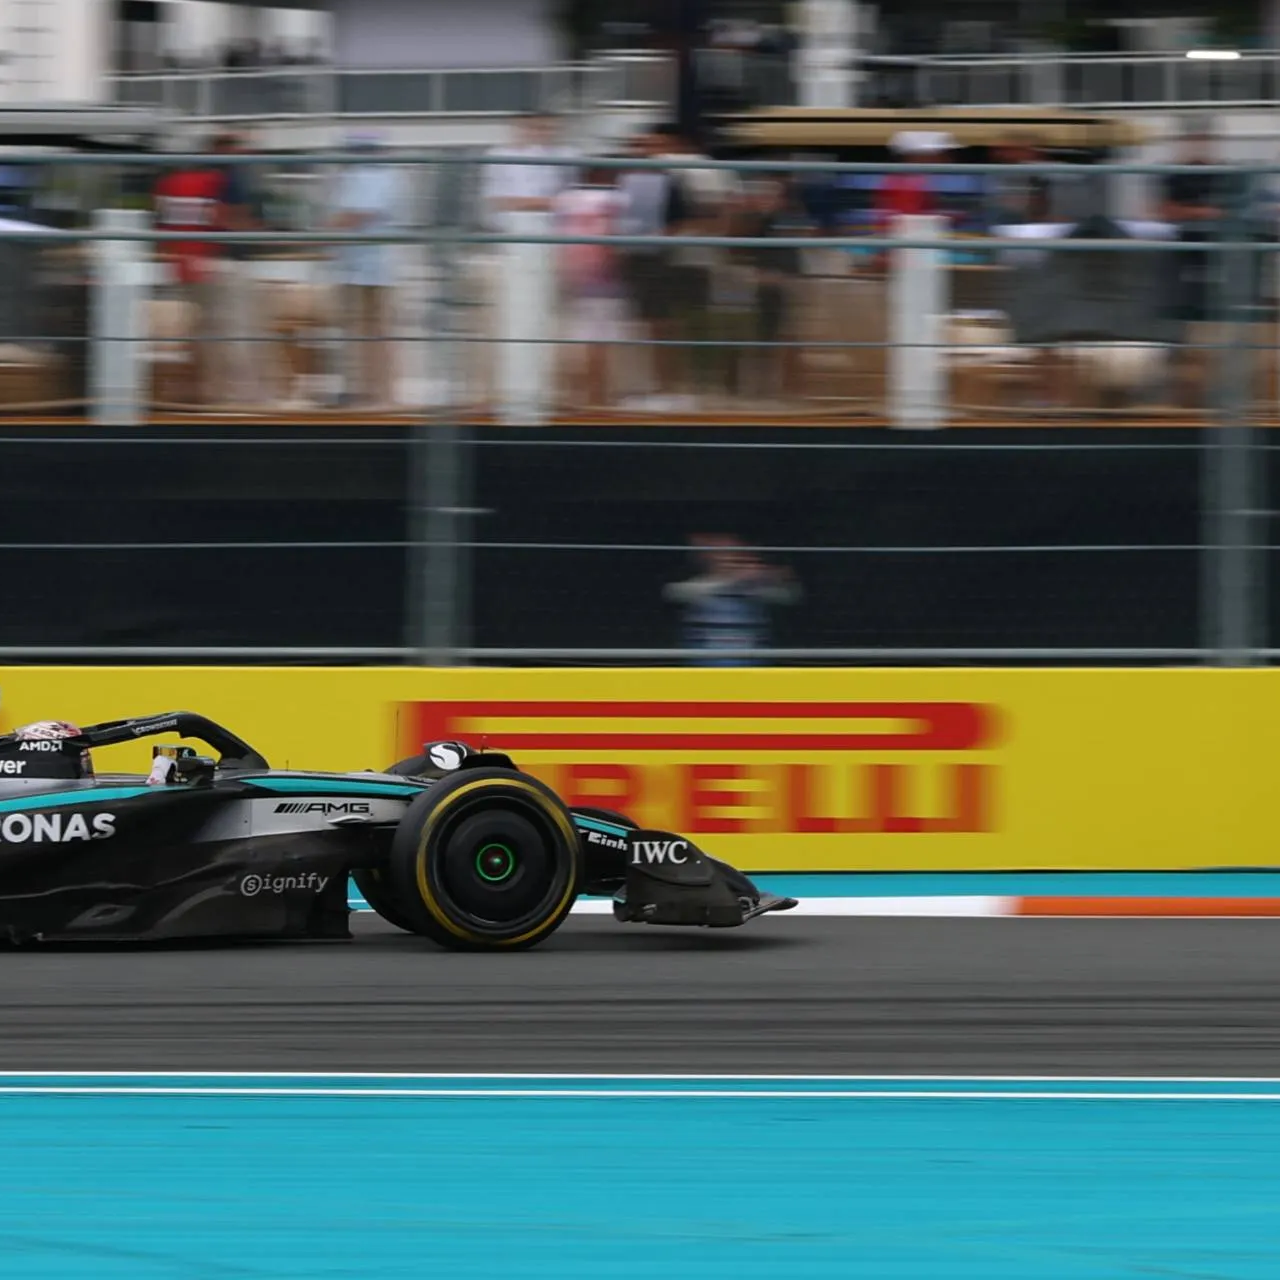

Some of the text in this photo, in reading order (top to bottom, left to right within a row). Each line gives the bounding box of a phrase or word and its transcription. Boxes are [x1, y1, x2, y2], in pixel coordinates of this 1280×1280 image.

[19, 740, 51, 752] AMD
[306, 803, 370, 814] AMG
[631, 840, 688, 865] IWC
